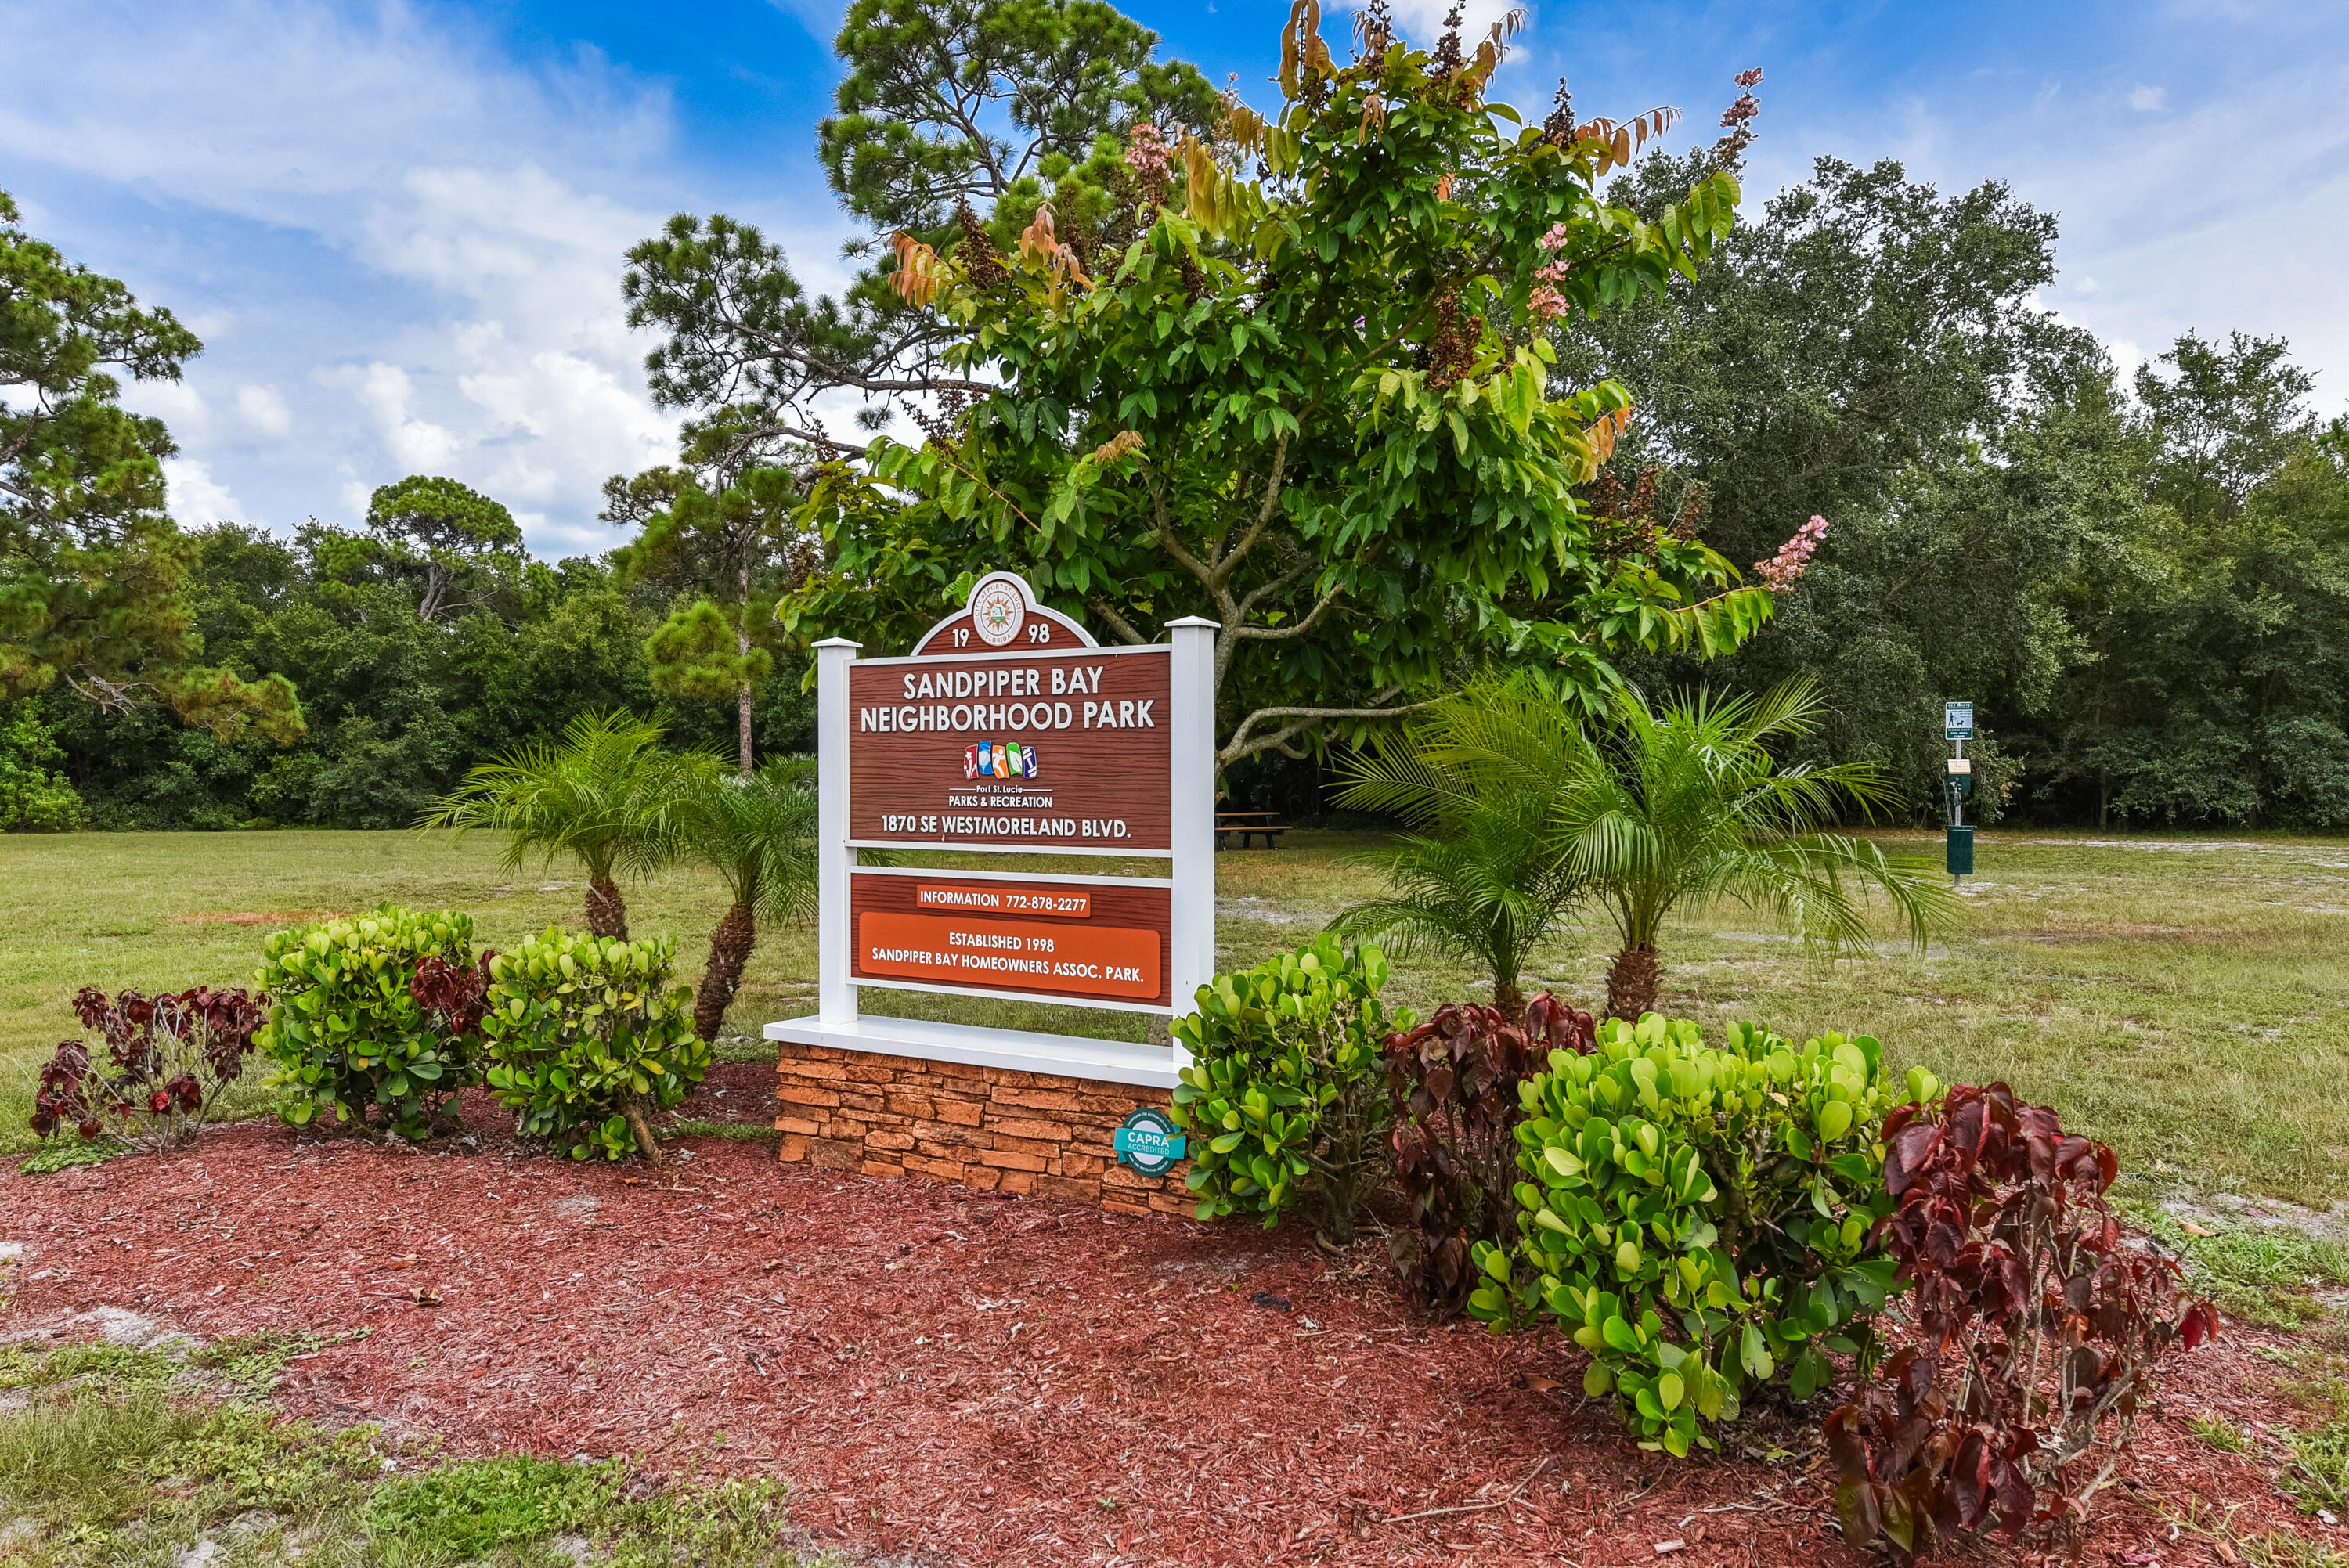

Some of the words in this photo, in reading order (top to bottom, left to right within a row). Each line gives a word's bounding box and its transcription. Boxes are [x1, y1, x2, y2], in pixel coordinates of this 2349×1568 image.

[987, 584, 1003, 593] PORT
[1012, 593, 1022, 614] LUCIE
[952, 628, 969, 648] 19
[1028, 623, 1050, 643] 98
[985, 634, 1012, 643] FLORIDA
[903, 669, 1041, 700] SANDPIPER
[1052, 666, 1104, 695] BAY
[861, 702, 1073, 733] NEIGHBORHOOD
[1084, 699, 1156, 729] PARK
[976, 784, 990, 793] Port
[993, 784, 1001, 793] St.
[1003, 784, 1023, 794] Lucie
[948, 795, 978, 807] PARKS
[980, 796, 988, 807] &
[990, 796, 1052, 808] RECREATION
[882, 815, 916, 832] 1870
[920, 816, 937, 833] SE
[941, 816, 1076, 837] WESTMORELAND
[1081, 819, 1131, 838] BLVD.
[920, 890, 1000, 907] INFORMATION
[1006, 895, 1087, 912] 772-878-2277
[949, 932, 1022, 950] ESTABLISHED
[1026, 937, 1054, 953] 1998
[872, 947, 932, 964] SANDPIPER
[935, 953, 959, 966] BAY
[962, 954, 1050, 975] HOMEOWNERS
[1053, 962, 1102, 979] ASSOC.
[1106, 966, 1144, 982] PARK.
[1128, 1131, 1170, 1148] CAPRA
[1128, 1143, 1170, 1155] ACCREDITED
